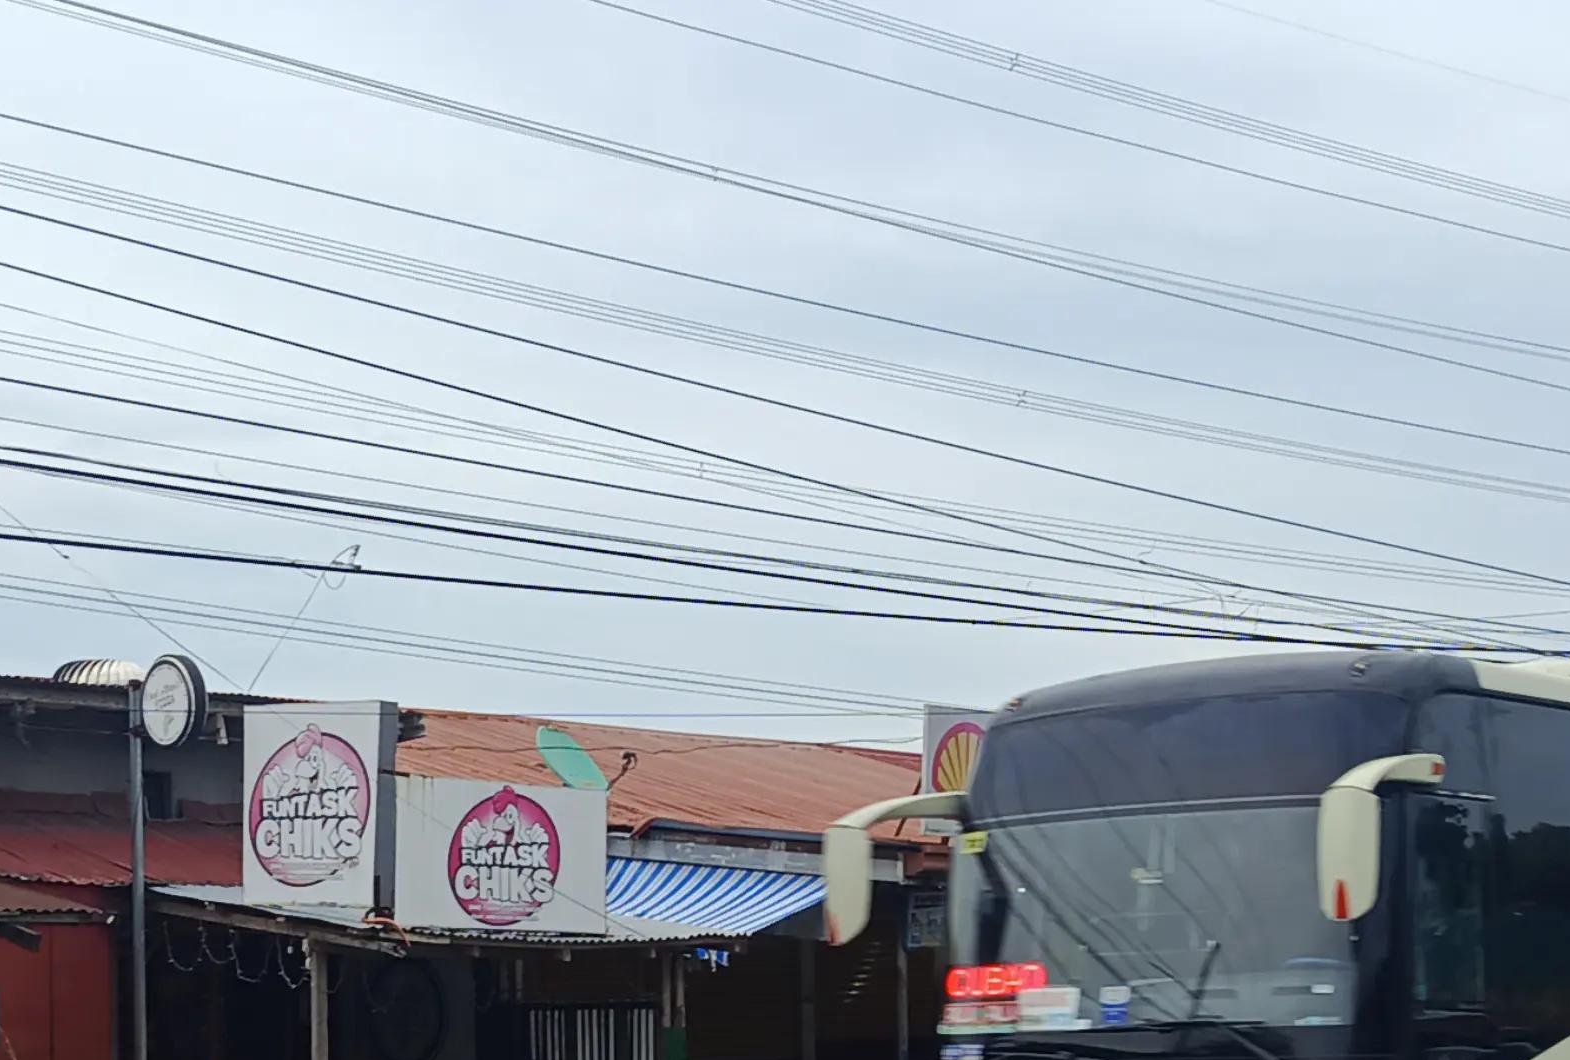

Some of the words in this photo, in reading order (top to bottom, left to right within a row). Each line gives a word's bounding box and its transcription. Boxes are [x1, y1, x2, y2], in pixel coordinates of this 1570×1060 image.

[261, 788, 359, 819] FUNTASK
[255, 818, 363, 860] CHIKS
[461, 843, 550, 867] FUNTASK
[454, 865, 555, 903] CHIKS
